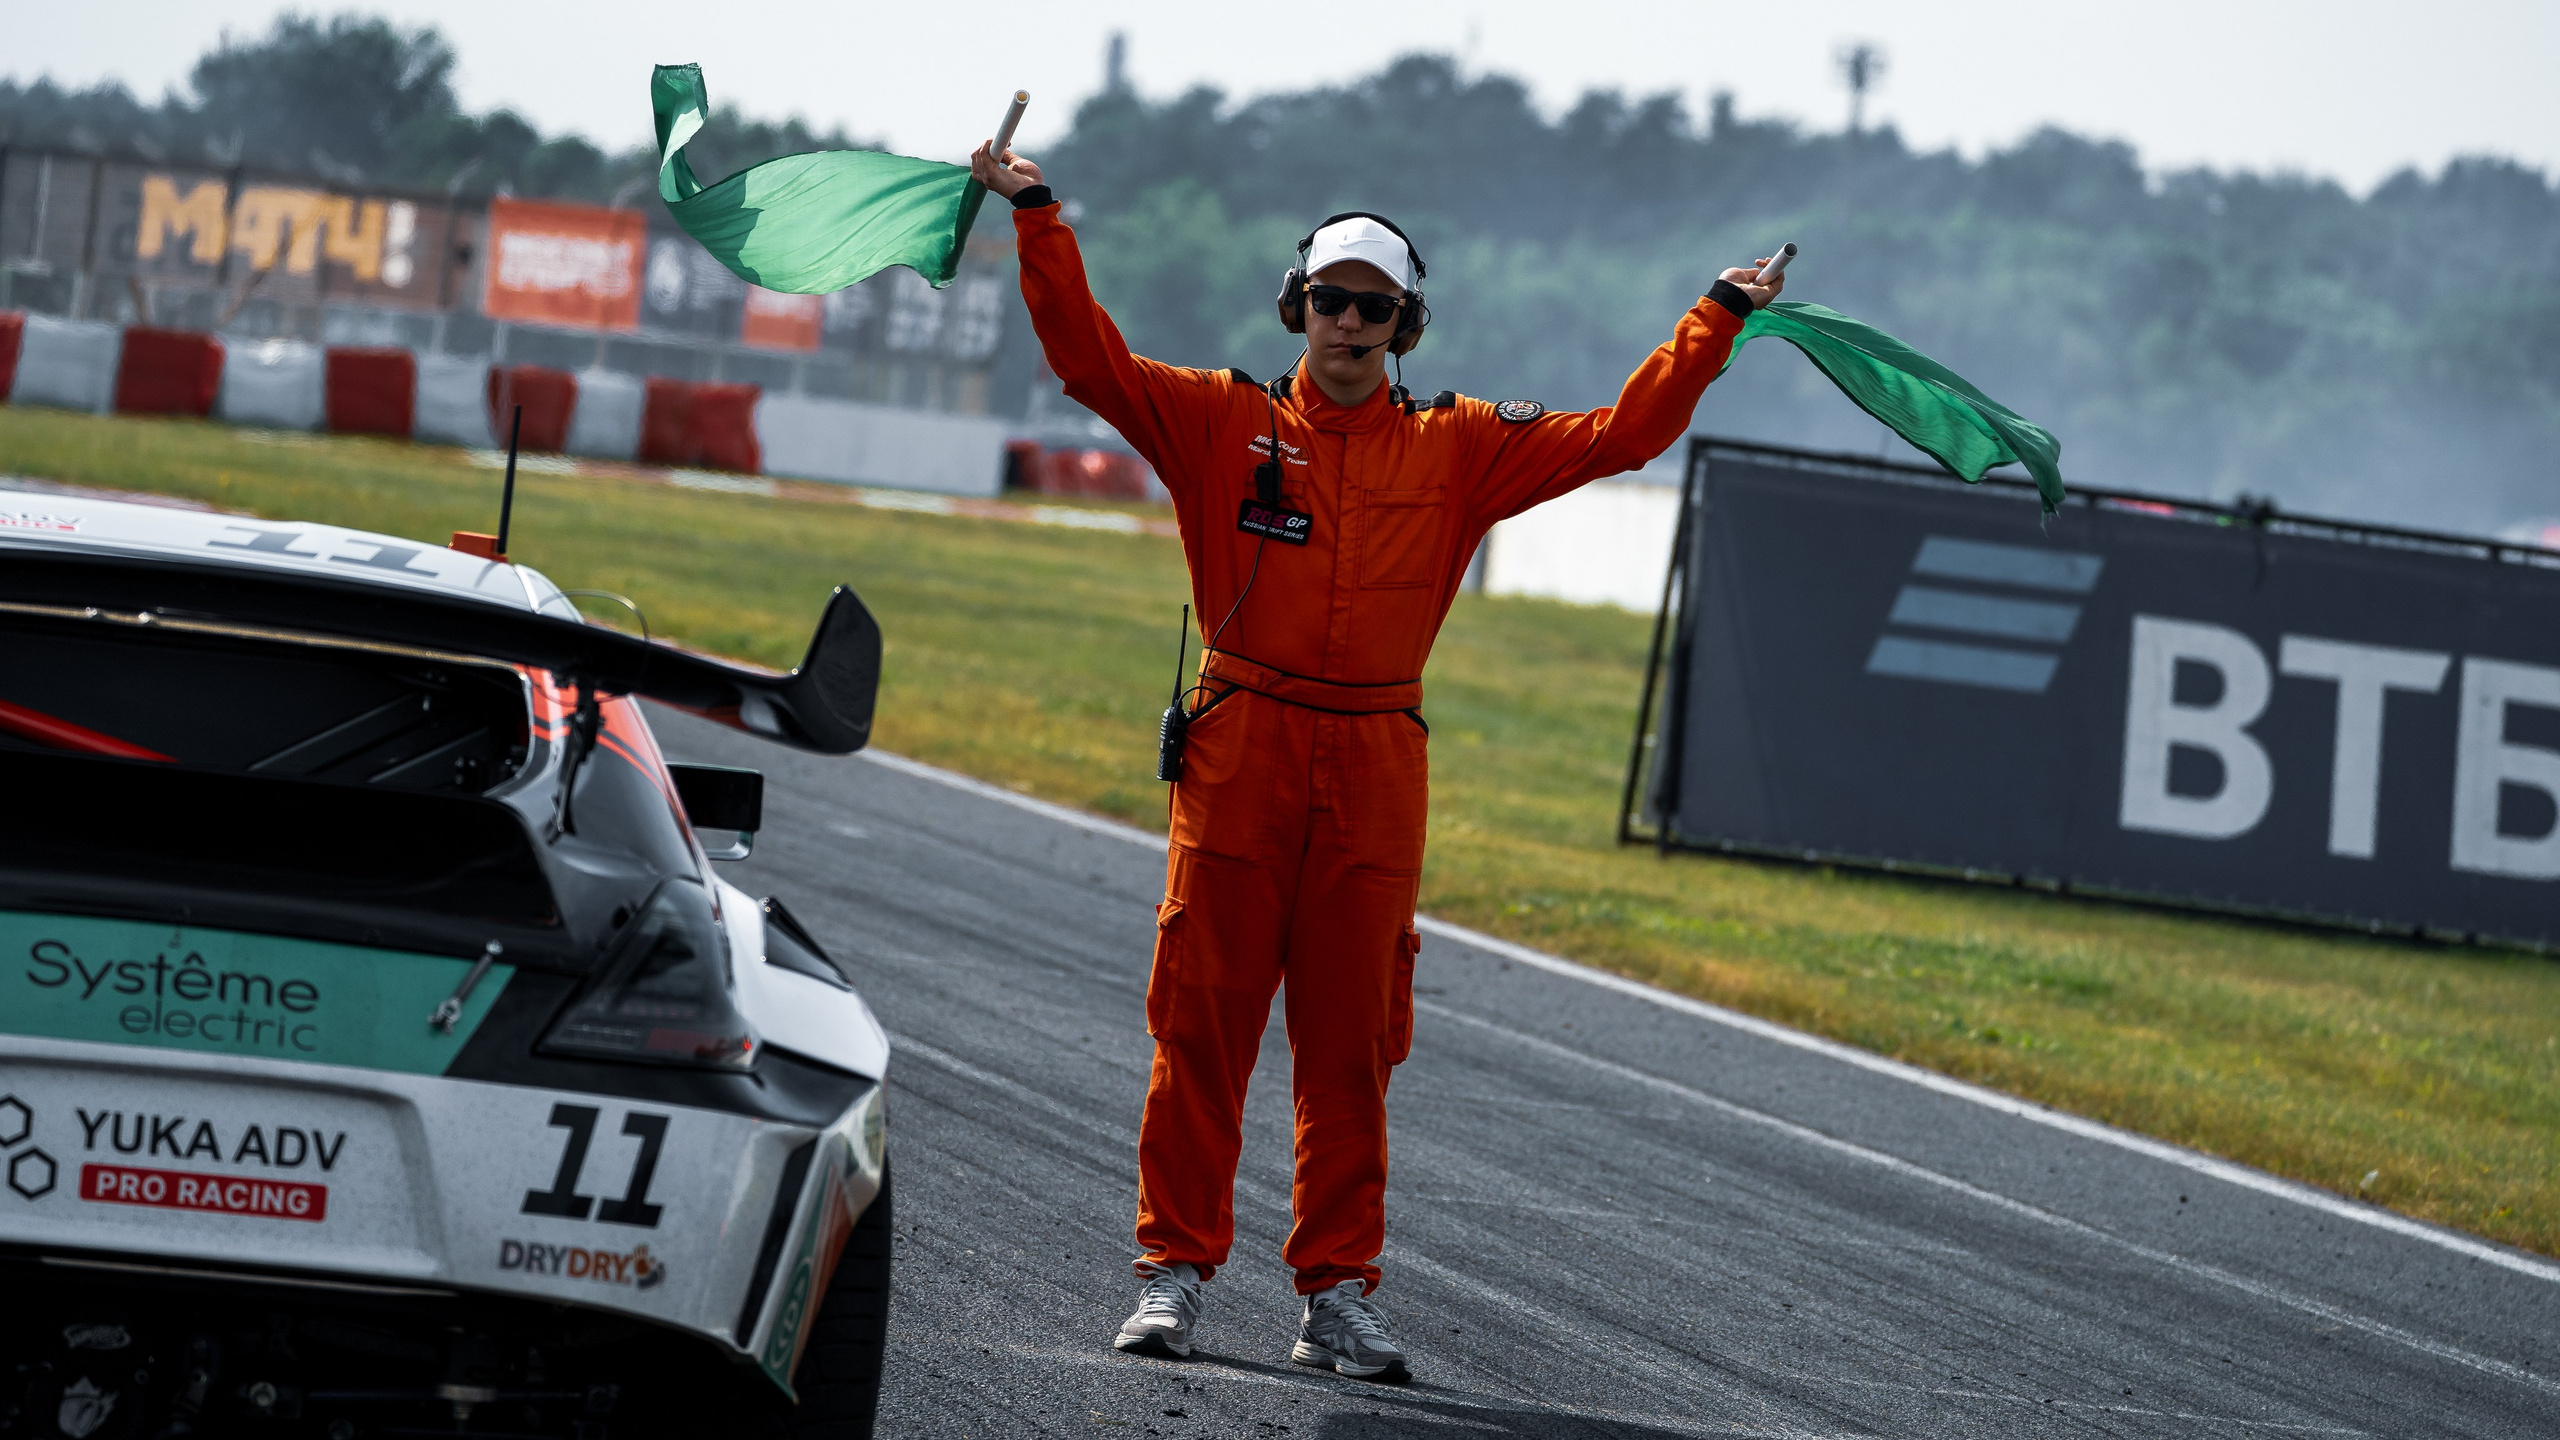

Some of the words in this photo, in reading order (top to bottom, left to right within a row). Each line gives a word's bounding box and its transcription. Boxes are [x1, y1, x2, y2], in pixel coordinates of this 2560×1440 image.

[1286, 456, 1309, 466] Team
[1242, 520, 1267, 531] RUSSIAN
[1283, 530, 1305, 540] SERIES
[1286, 516, 1308, 529] GP
[206, 525, 439, 577] 11
[2119, 613, 2560, 883] ВТБ
[26, 939, 320, 1013] Système
[118, 999, 320, 1052] electric
[75, 1107, 222, 1162] YUKA
[233, 1123, 347, 1172] ADV
[521, 1102, 671, 1229] 11
[95, 1170, 167, 1202] PRO
[176, 1178, 312, 1215] RACING
